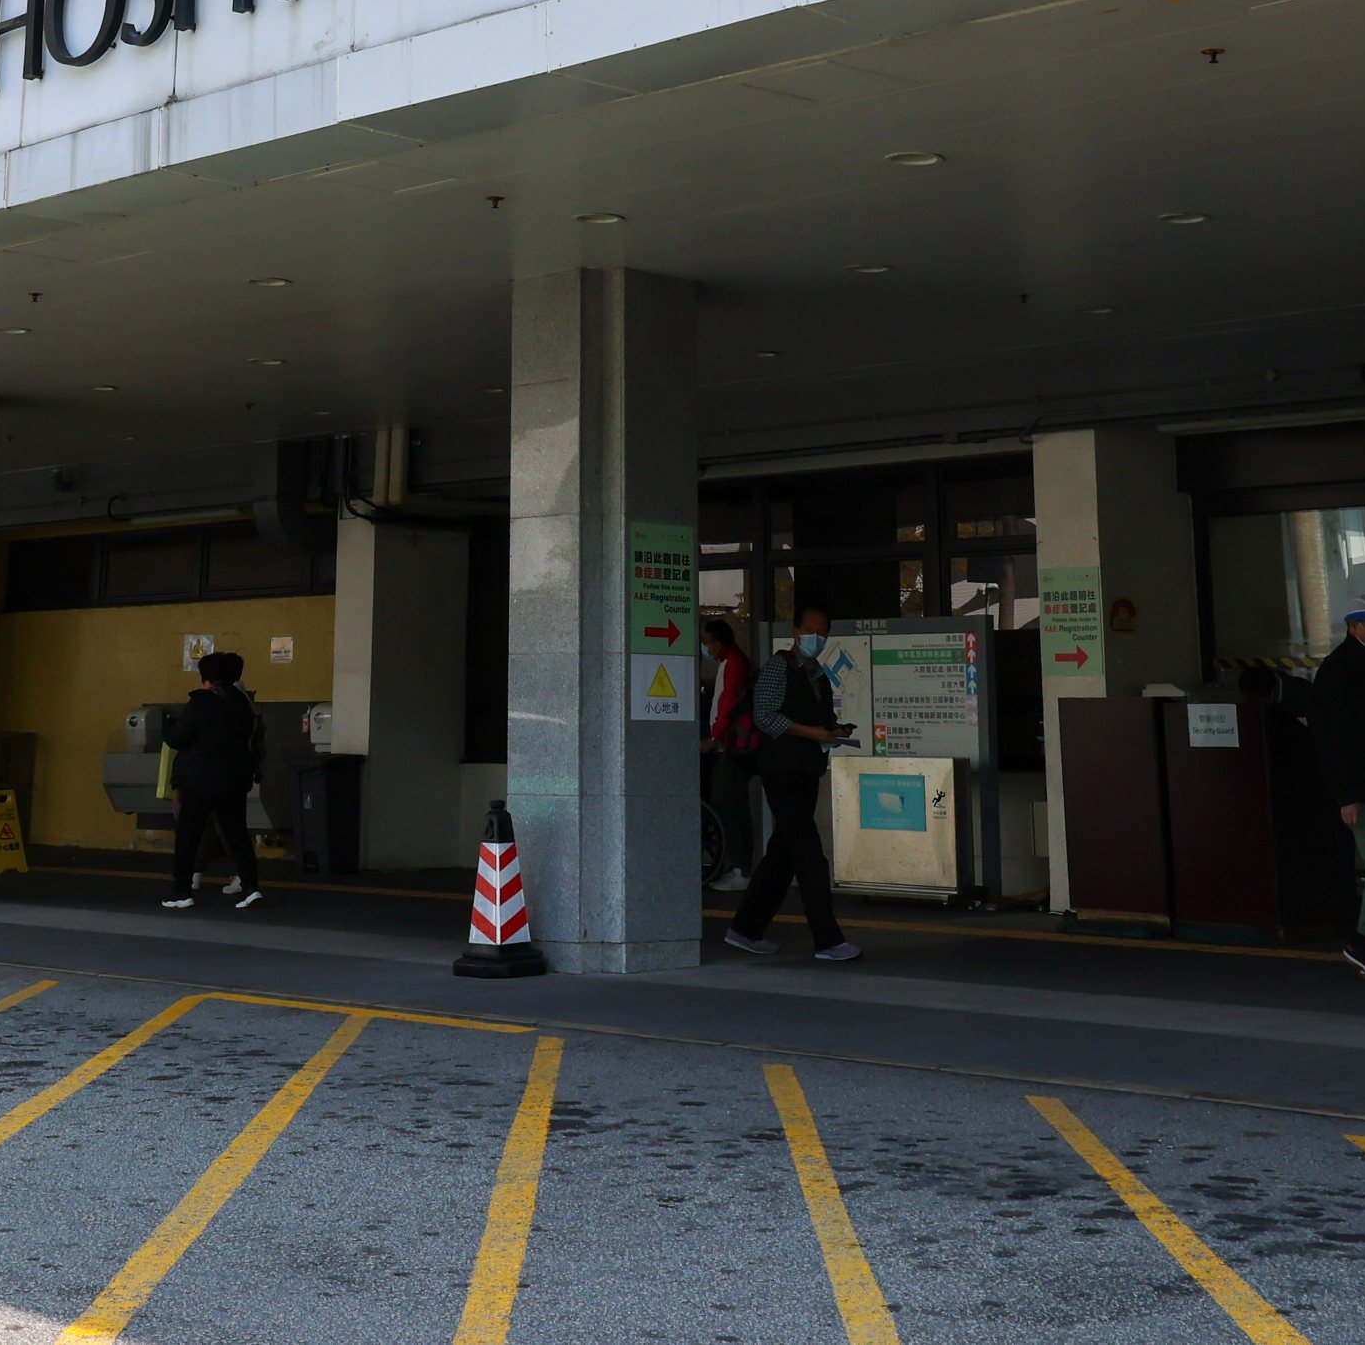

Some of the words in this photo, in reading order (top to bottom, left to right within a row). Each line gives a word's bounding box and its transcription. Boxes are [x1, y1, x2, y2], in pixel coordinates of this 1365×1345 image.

[634, 551, 691, 566] 請沿此路前往
[634, 566, 691, 582] 急症室登記處
[634, 592, 649, 601] A&E
[650, 593, 691, 605] Registration
[1043, 591, 1096, 602] 請沿此路前往
[664, 604, 691, 615] Counter
[1059, 625, 1097, 634] Registration
[1072, 633, 1097, 642] Counter
[645, 702, 679, 715] 小心地滑
[1192, 727, 1215, 736] Security
[1216, 727, 1235, 735] Guard
